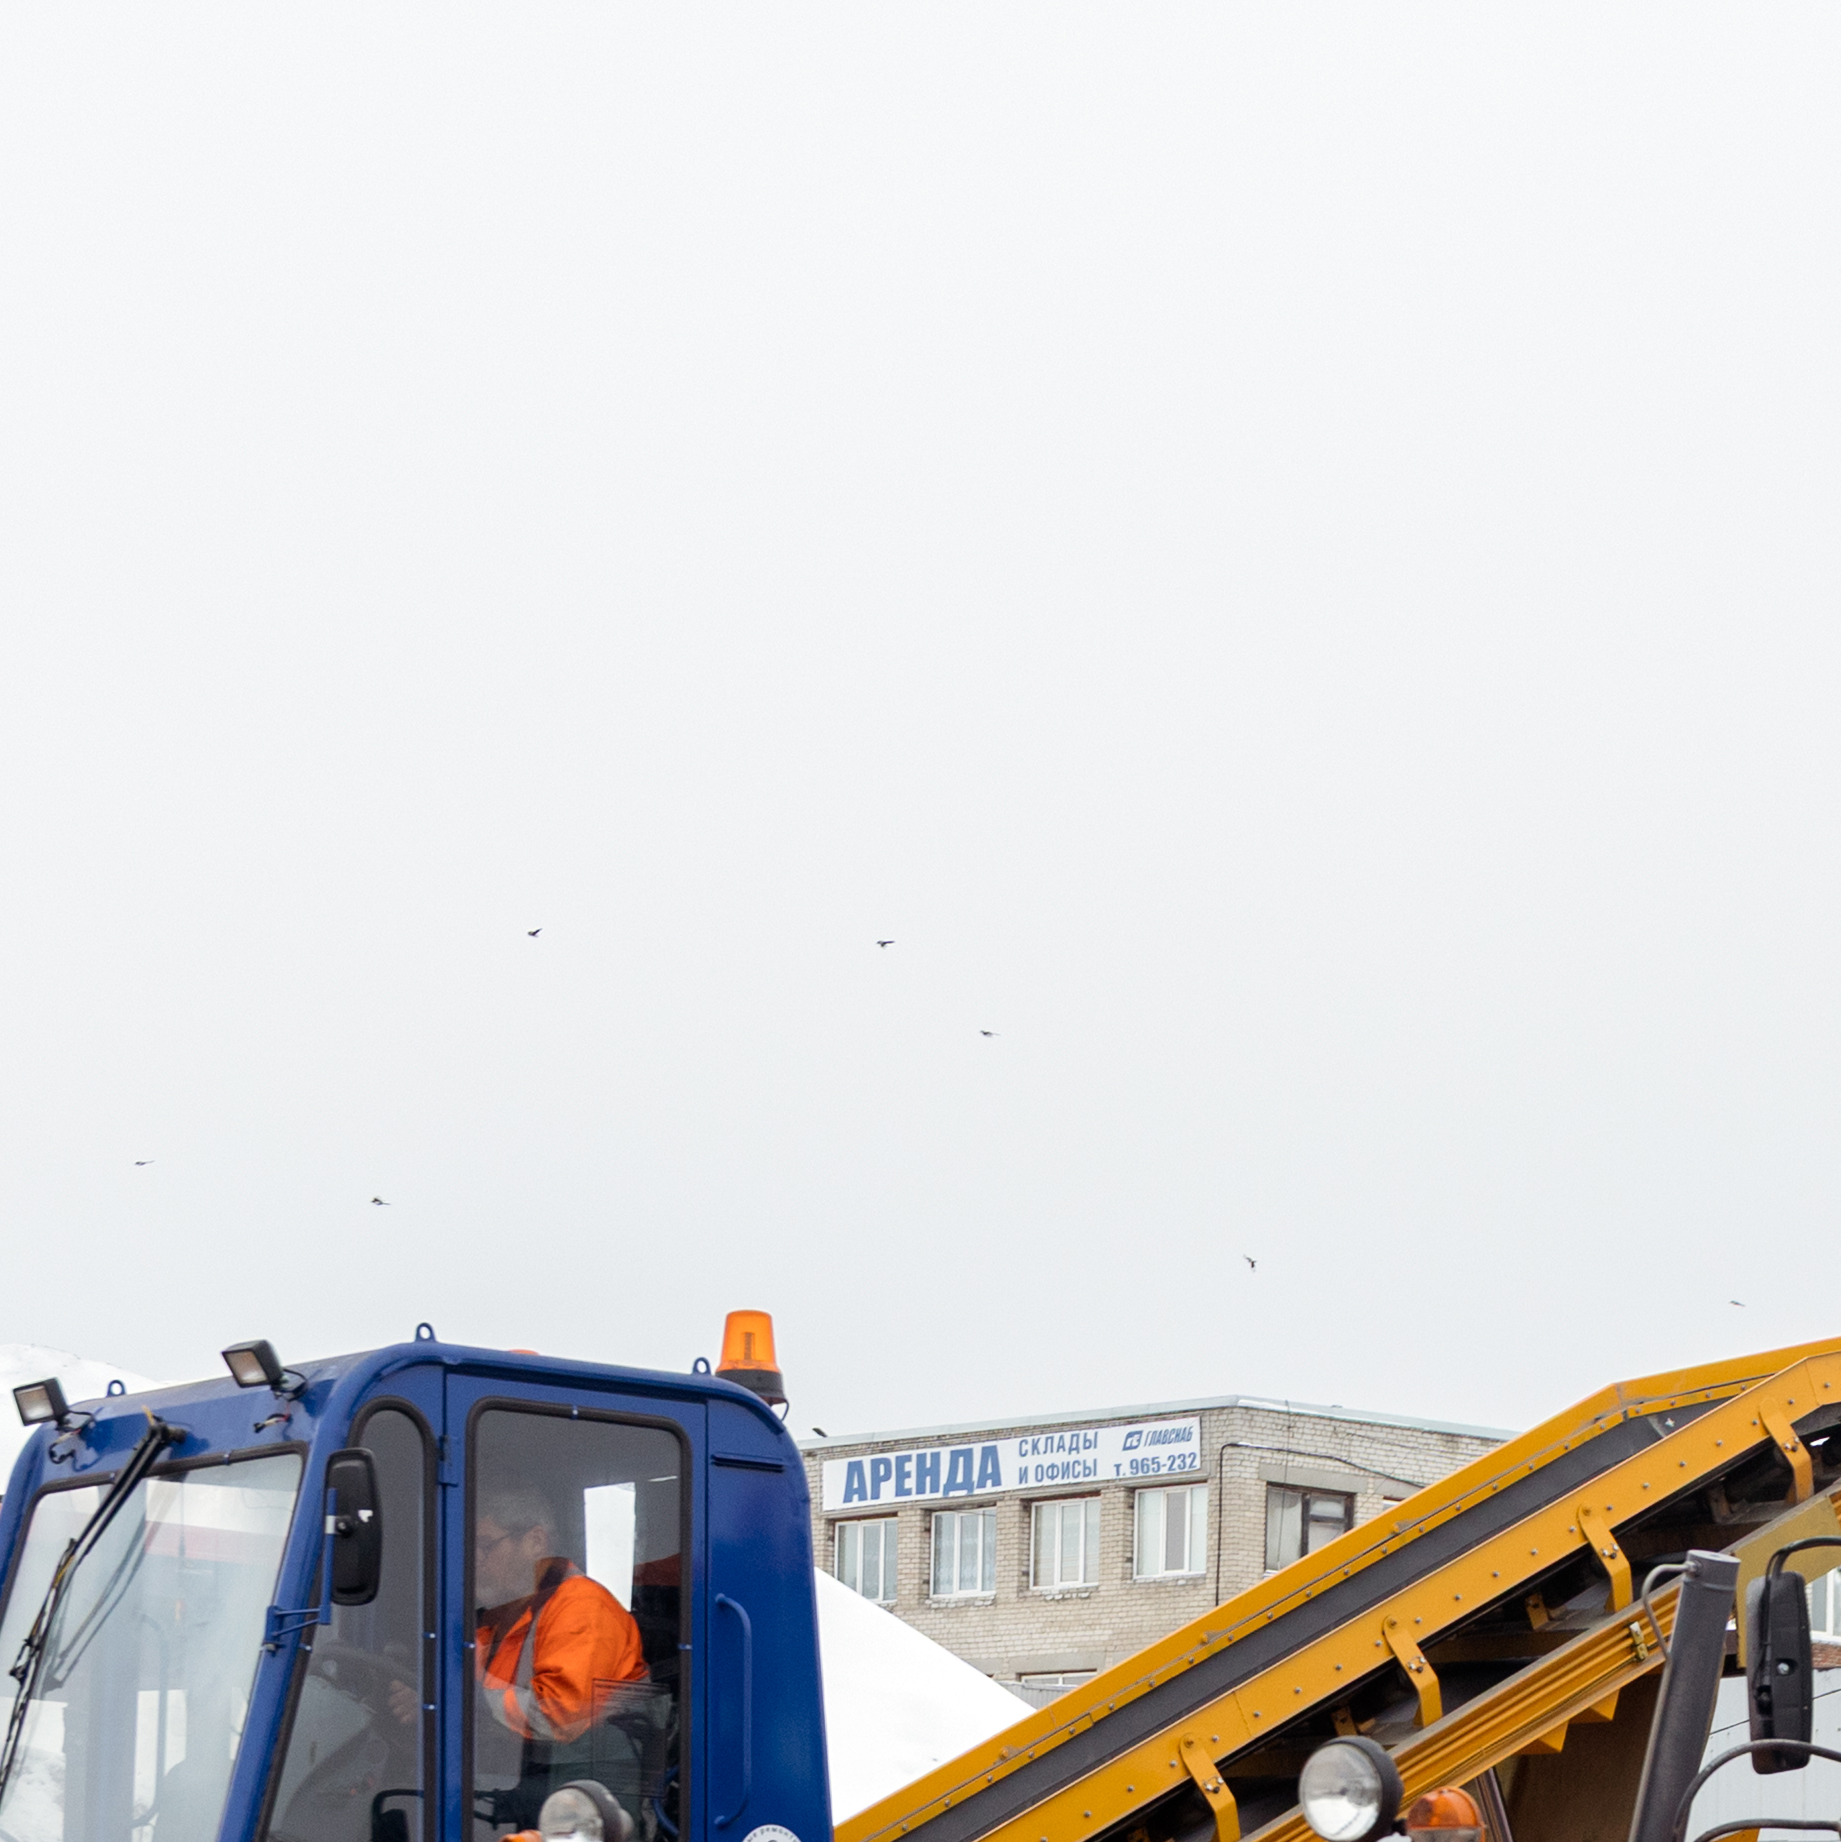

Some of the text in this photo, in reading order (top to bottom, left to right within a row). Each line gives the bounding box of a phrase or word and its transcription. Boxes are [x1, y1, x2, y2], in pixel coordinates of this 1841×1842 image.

[1018, 1431, 1098, 1458] СКЛАДЫ
[1143, 1426, 1193, 1447] ГЛАВСНАБ
[842, 1445, 1002, 1504] АРЕНДА
[1018, 1458, 1097, 1485] И ОФИСЫ
[1130, 1452, 1197, 1476] 965-232
